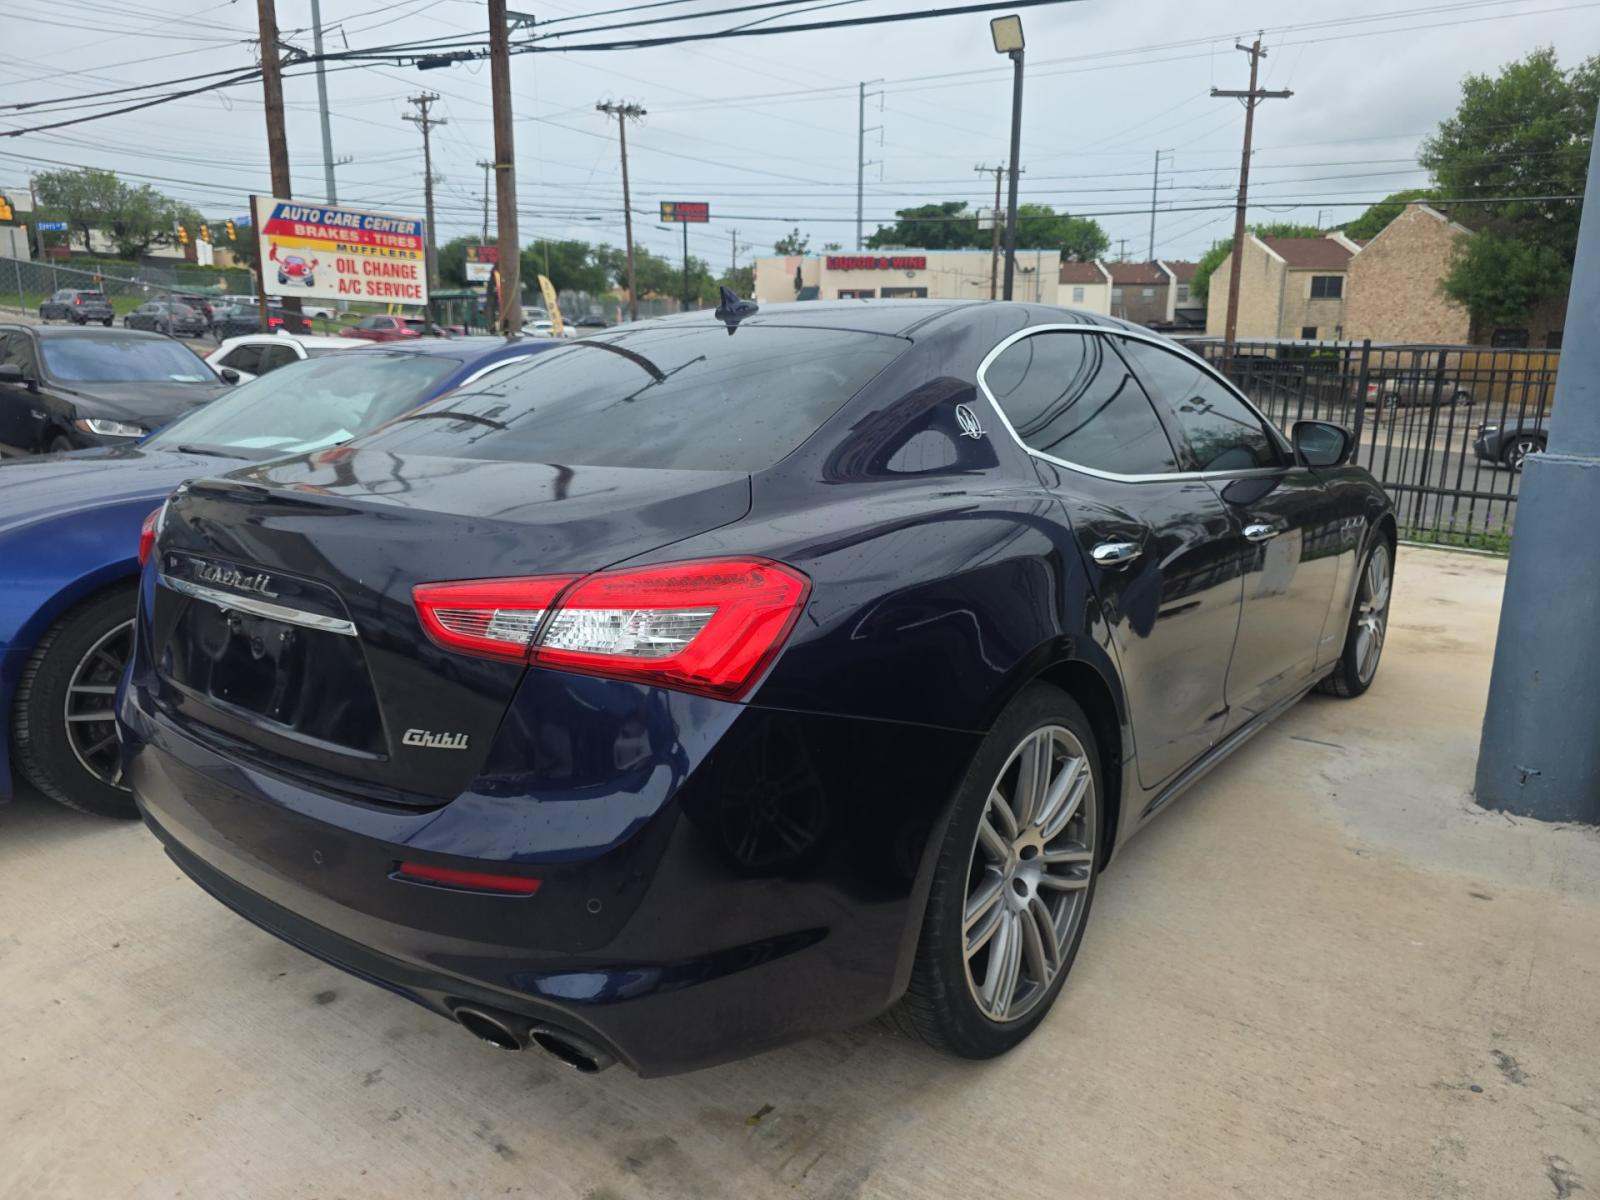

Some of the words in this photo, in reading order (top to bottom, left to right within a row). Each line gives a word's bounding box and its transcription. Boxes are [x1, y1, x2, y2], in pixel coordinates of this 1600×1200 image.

[280, 206, 320, 223] AUTO
[324, 211, 361, 228] CARE
[364, 215, 415, 234] CENTER
[294, 224, 359, 242] BRAKES
[374, 234, 417, 248] TIRES
[336, 243, 417, 260] MUFFLERS
[336, 258, 359, 276] OIL
[363, 261, 417, 280] CHANGE
[338, 278, 362, 295] A/C
[366, 281, 422, 299] SERVICE
[402, 728, 469, 749] Ghibli
